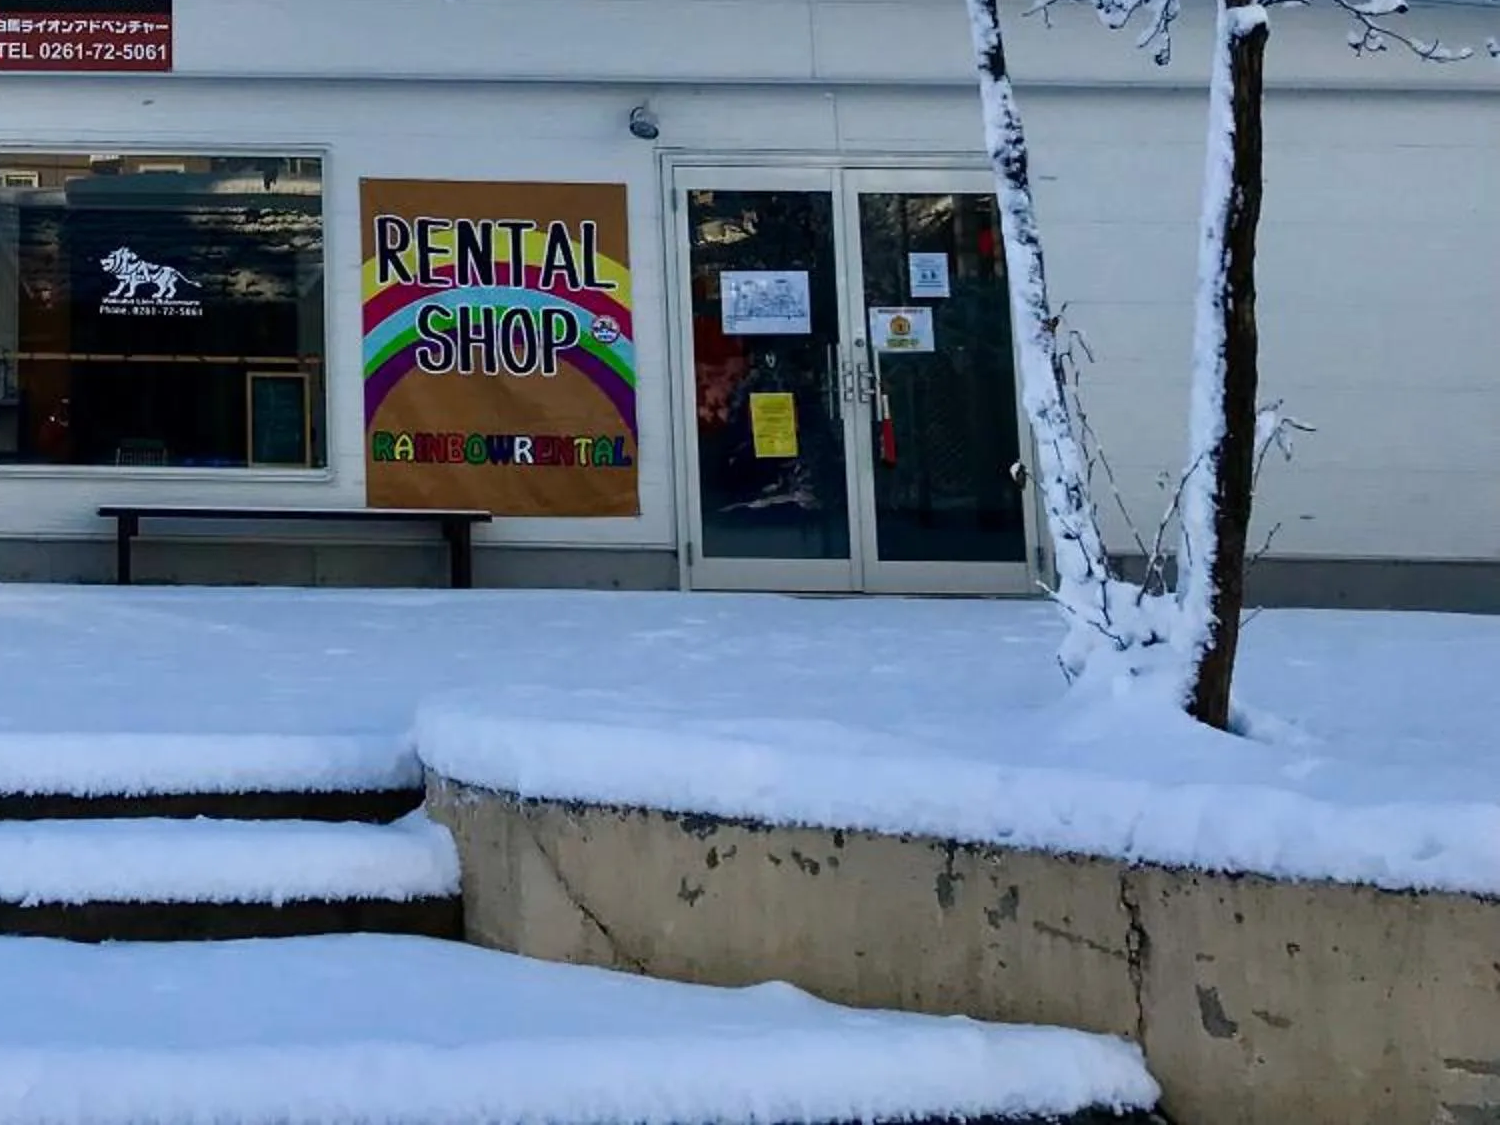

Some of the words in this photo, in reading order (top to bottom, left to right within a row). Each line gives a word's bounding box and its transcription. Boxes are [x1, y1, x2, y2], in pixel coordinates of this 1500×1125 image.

[39, 42, 167, 60] 0261-72-5061
[374, 215, 618, 291] RENTAL
[416, 304, 580, 375] SHOP
[372, 431, 632, 466] RAINBOWRENTAL
